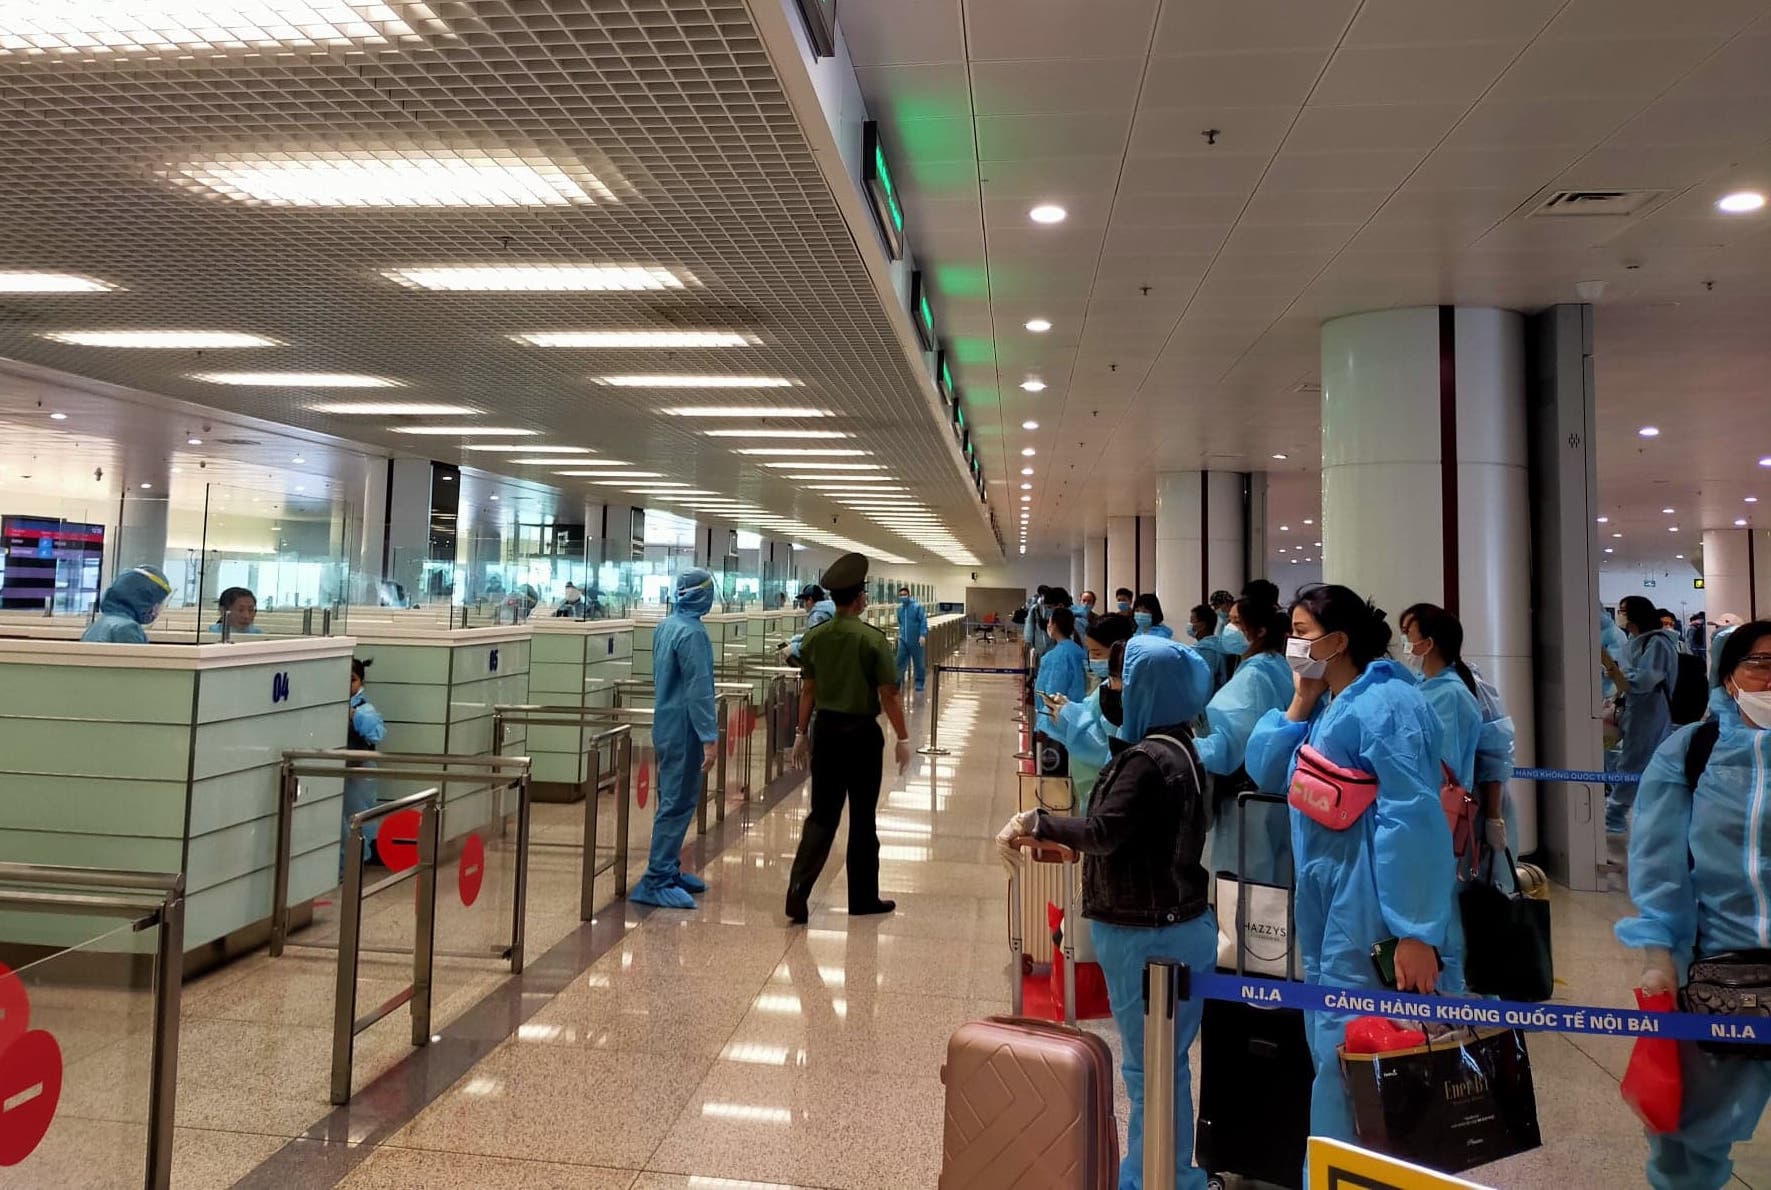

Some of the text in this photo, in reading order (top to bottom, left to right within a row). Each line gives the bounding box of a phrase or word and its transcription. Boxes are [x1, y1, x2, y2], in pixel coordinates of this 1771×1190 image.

[273, 672, 289, 702] 04
[1244, 922, 1286, 937] HAZZYS
[1242, 985, 1282, 1002] N.I.A
[1325, 991, 1659, 1034] CẢNG HÀNG KHÔNG QUỐC TẾ NỘI BÀI
[1711, 1023, 1757, 1039] N.I.A
